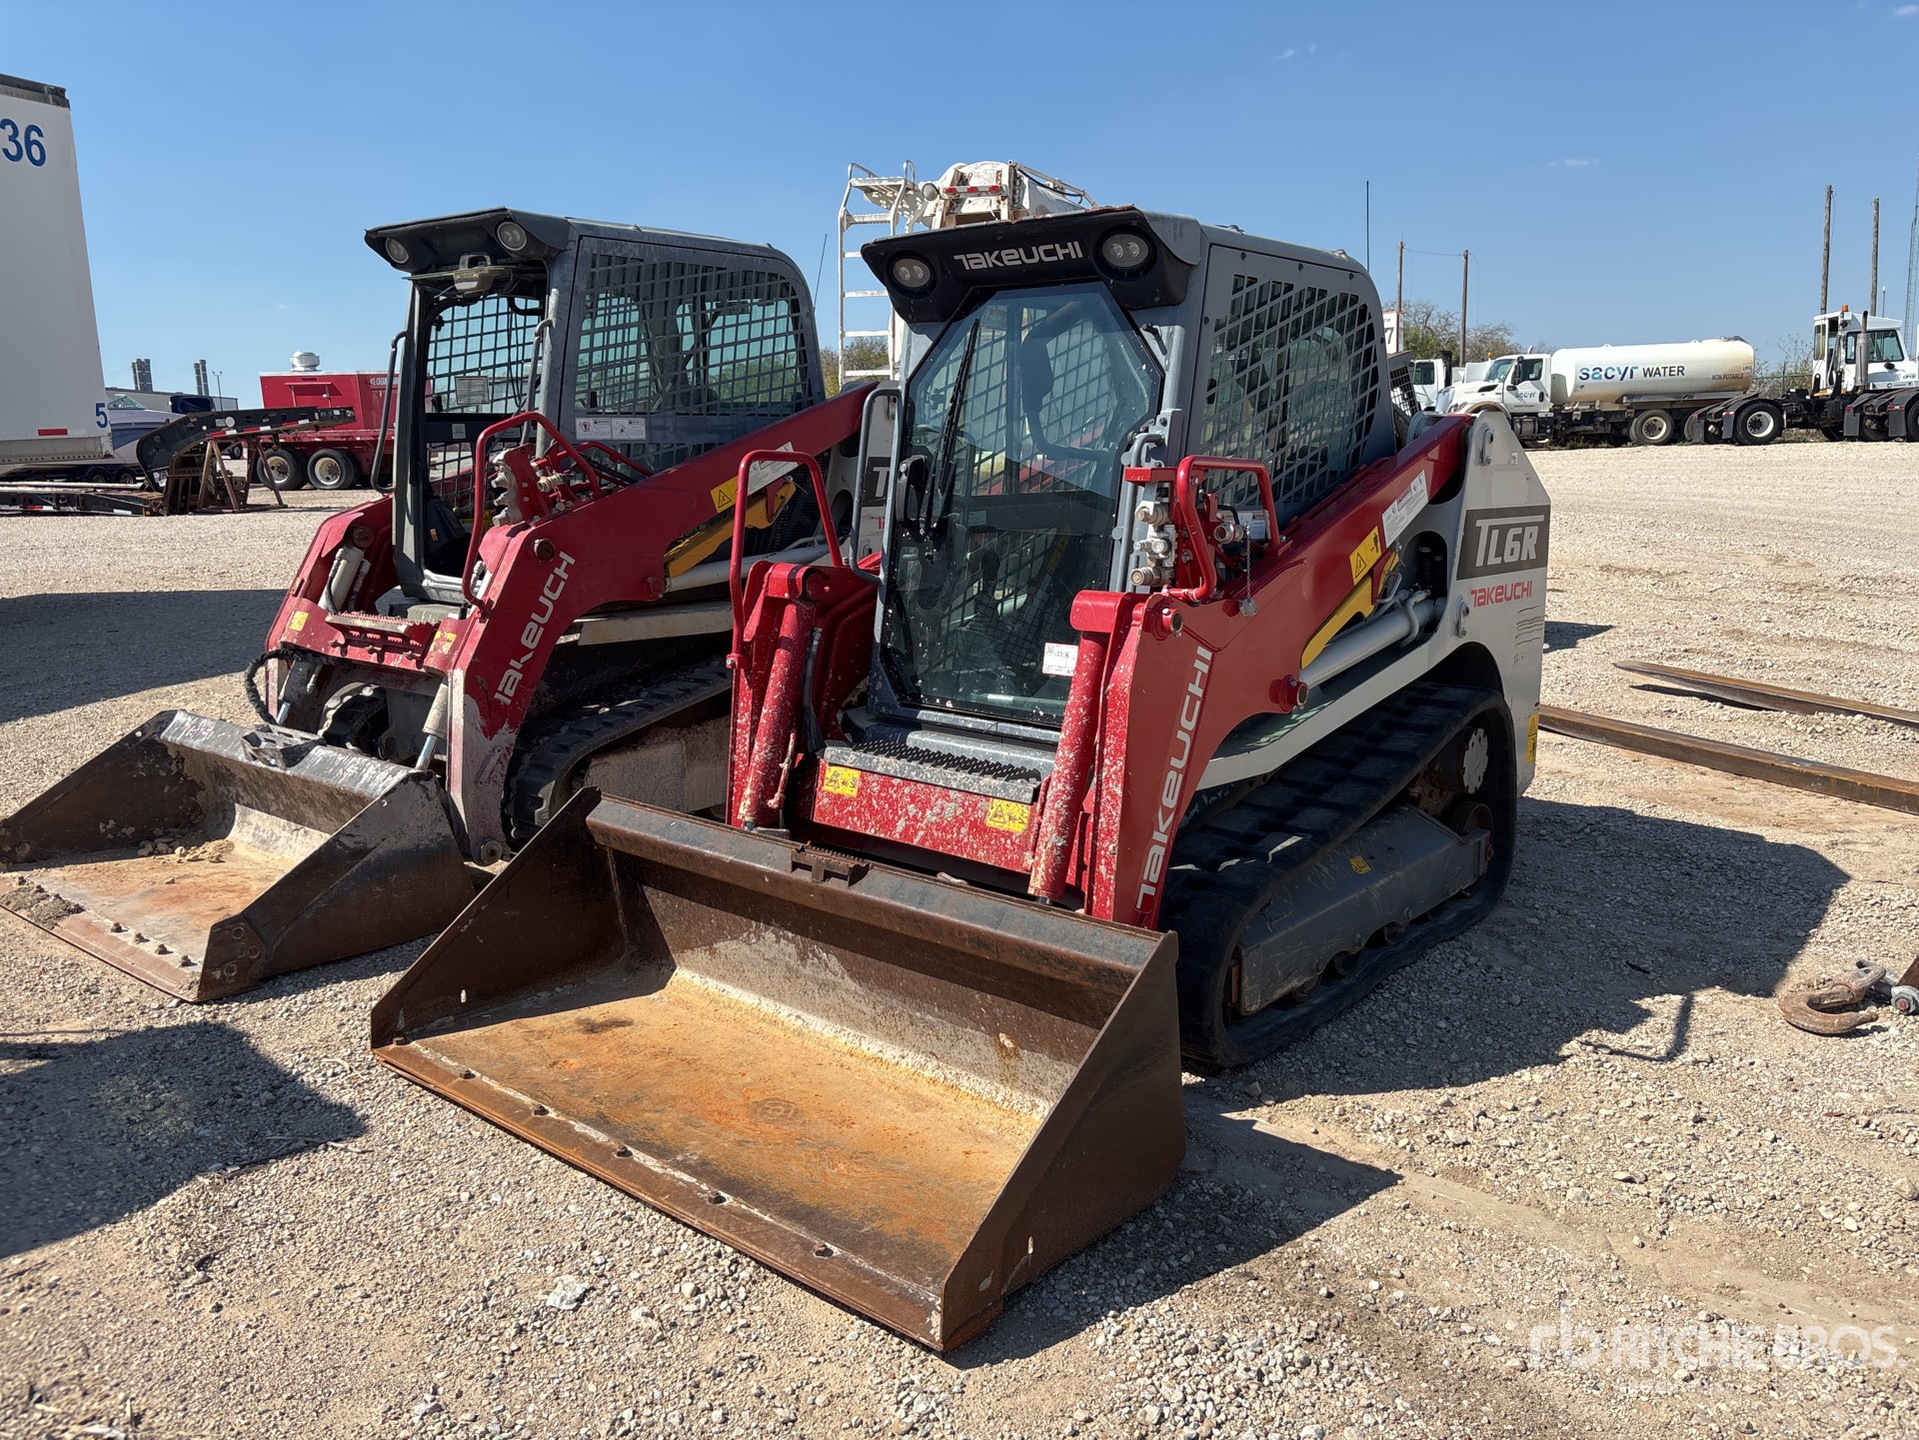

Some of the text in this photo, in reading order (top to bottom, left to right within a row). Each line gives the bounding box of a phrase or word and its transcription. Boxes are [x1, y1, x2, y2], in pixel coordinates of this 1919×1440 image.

[0, 118, 46, 167] 36
[953, 241, 1084, 271] TAKEUCHI
[1578, 365, 1685, 381] sacyr WATER
[1475, 514, 1544, 567] TL6R
[1471, 580, 1533, 608] TAKEUCHI
[1136, 645, 1212, 909] TAKEUCHI
